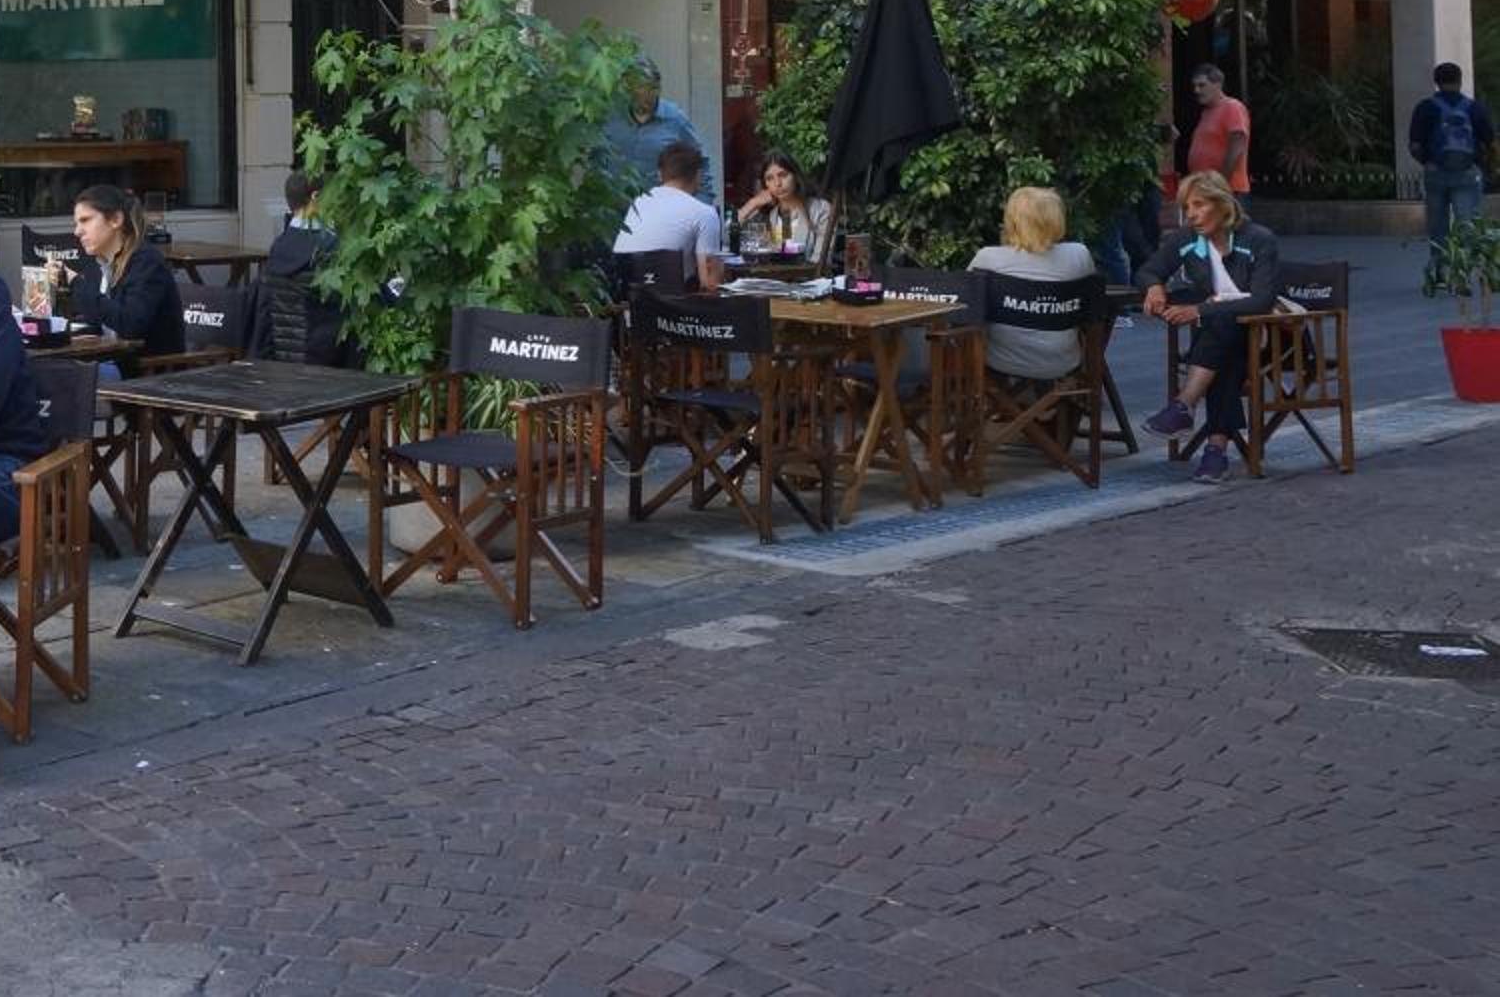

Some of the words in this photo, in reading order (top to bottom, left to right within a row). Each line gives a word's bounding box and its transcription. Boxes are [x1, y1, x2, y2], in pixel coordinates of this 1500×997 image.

[1003, 296, 1081, 314] MARTINEZ
[183, 310, 225, 328] RTINEZ
[657, 316, 736, 339] MARTINEZ
[489, 336, 580, 361] MARTINEZ
